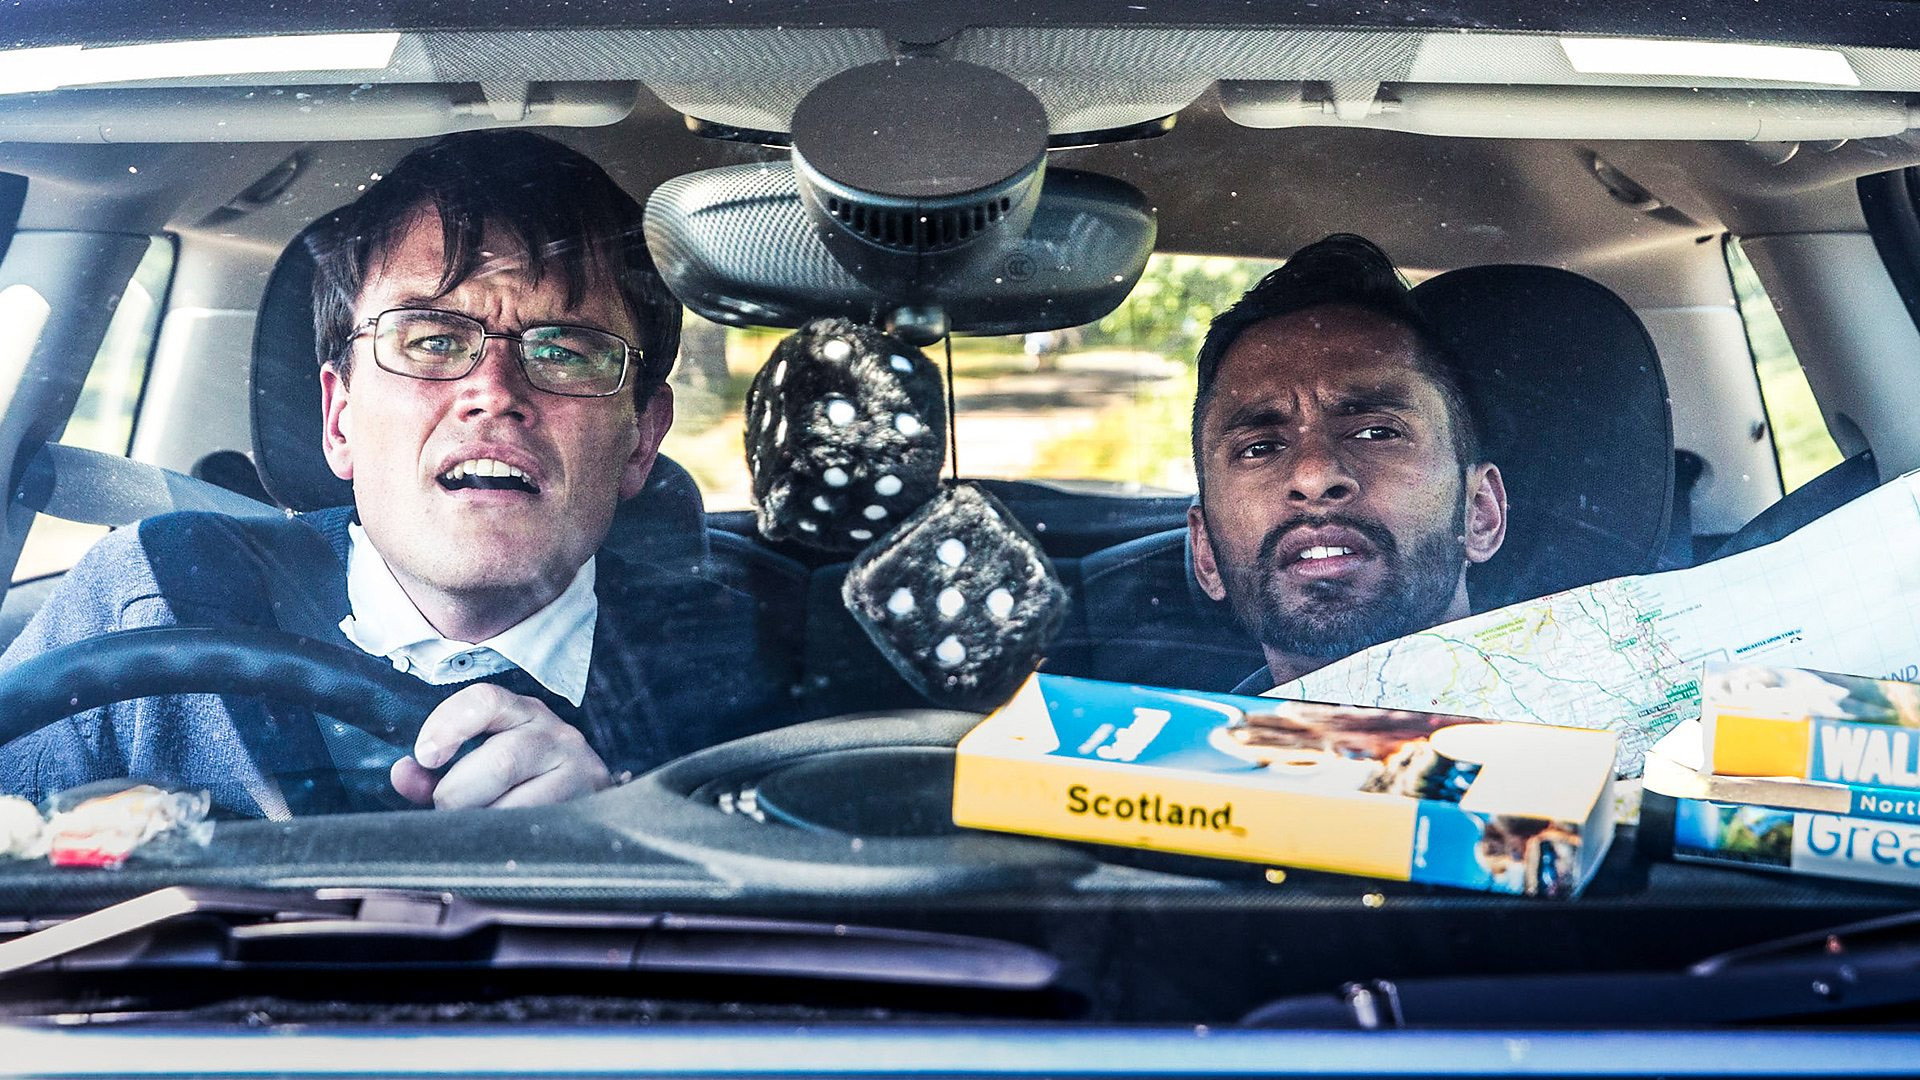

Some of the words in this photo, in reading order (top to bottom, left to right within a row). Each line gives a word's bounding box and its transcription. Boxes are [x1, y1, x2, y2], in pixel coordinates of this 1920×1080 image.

[1881, 664, 1918, 682] ND
[1821, 725, 1920, 788] WAL
[1068, 784, 1233, 830] Scotland
[1860, 794, 1920, 816] Nort
